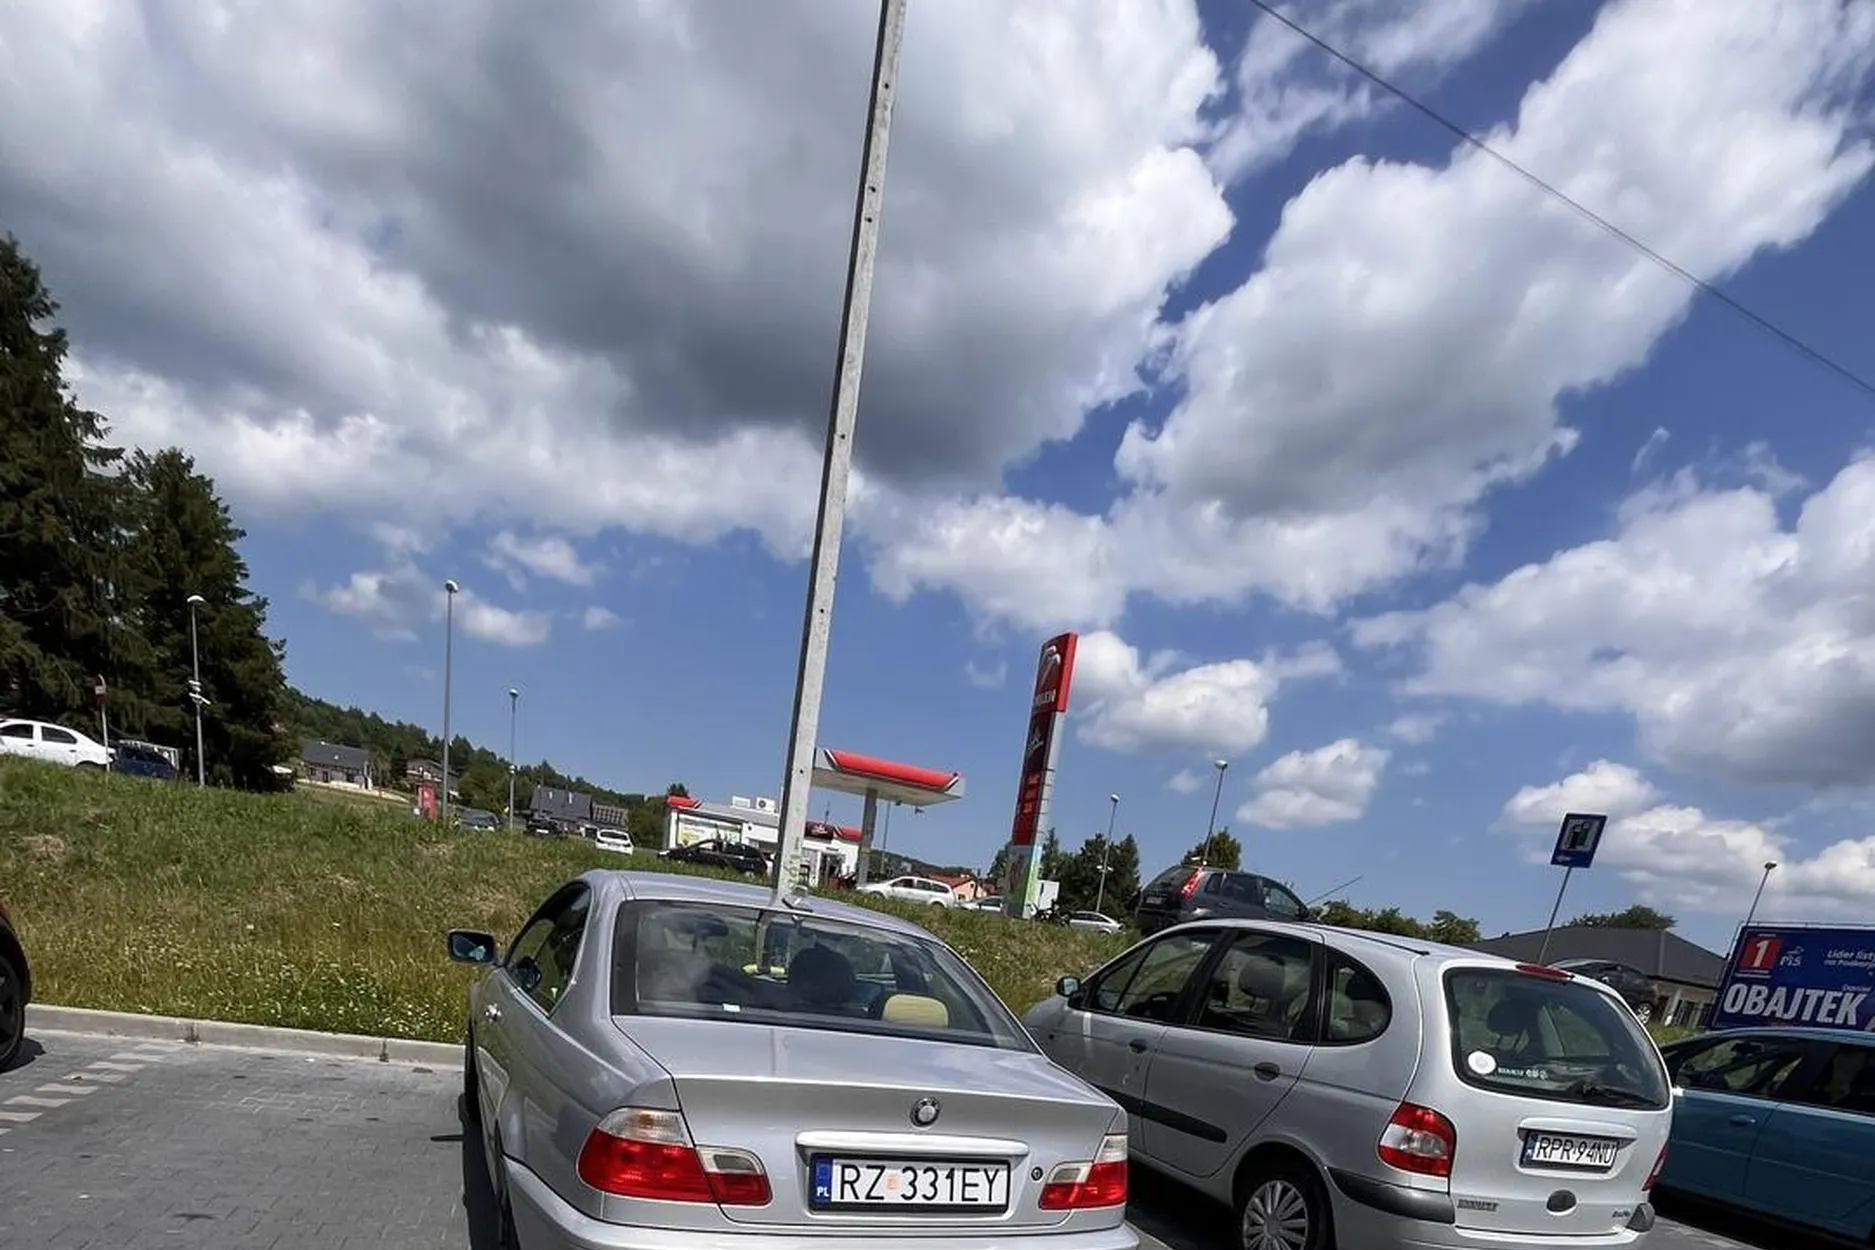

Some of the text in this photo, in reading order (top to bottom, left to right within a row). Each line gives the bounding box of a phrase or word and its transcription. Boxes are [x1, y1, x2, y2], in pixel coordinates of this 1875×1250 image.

[1751, 939, 1770, 968] 1
[1723, 983, 1867, 1026] OBAJTEK
[1536, 1136, 1574, 1160] RPR
[816, 1186, 830, 1198] PL
[839, 1164, 1000, 1202] RZ 331EY
